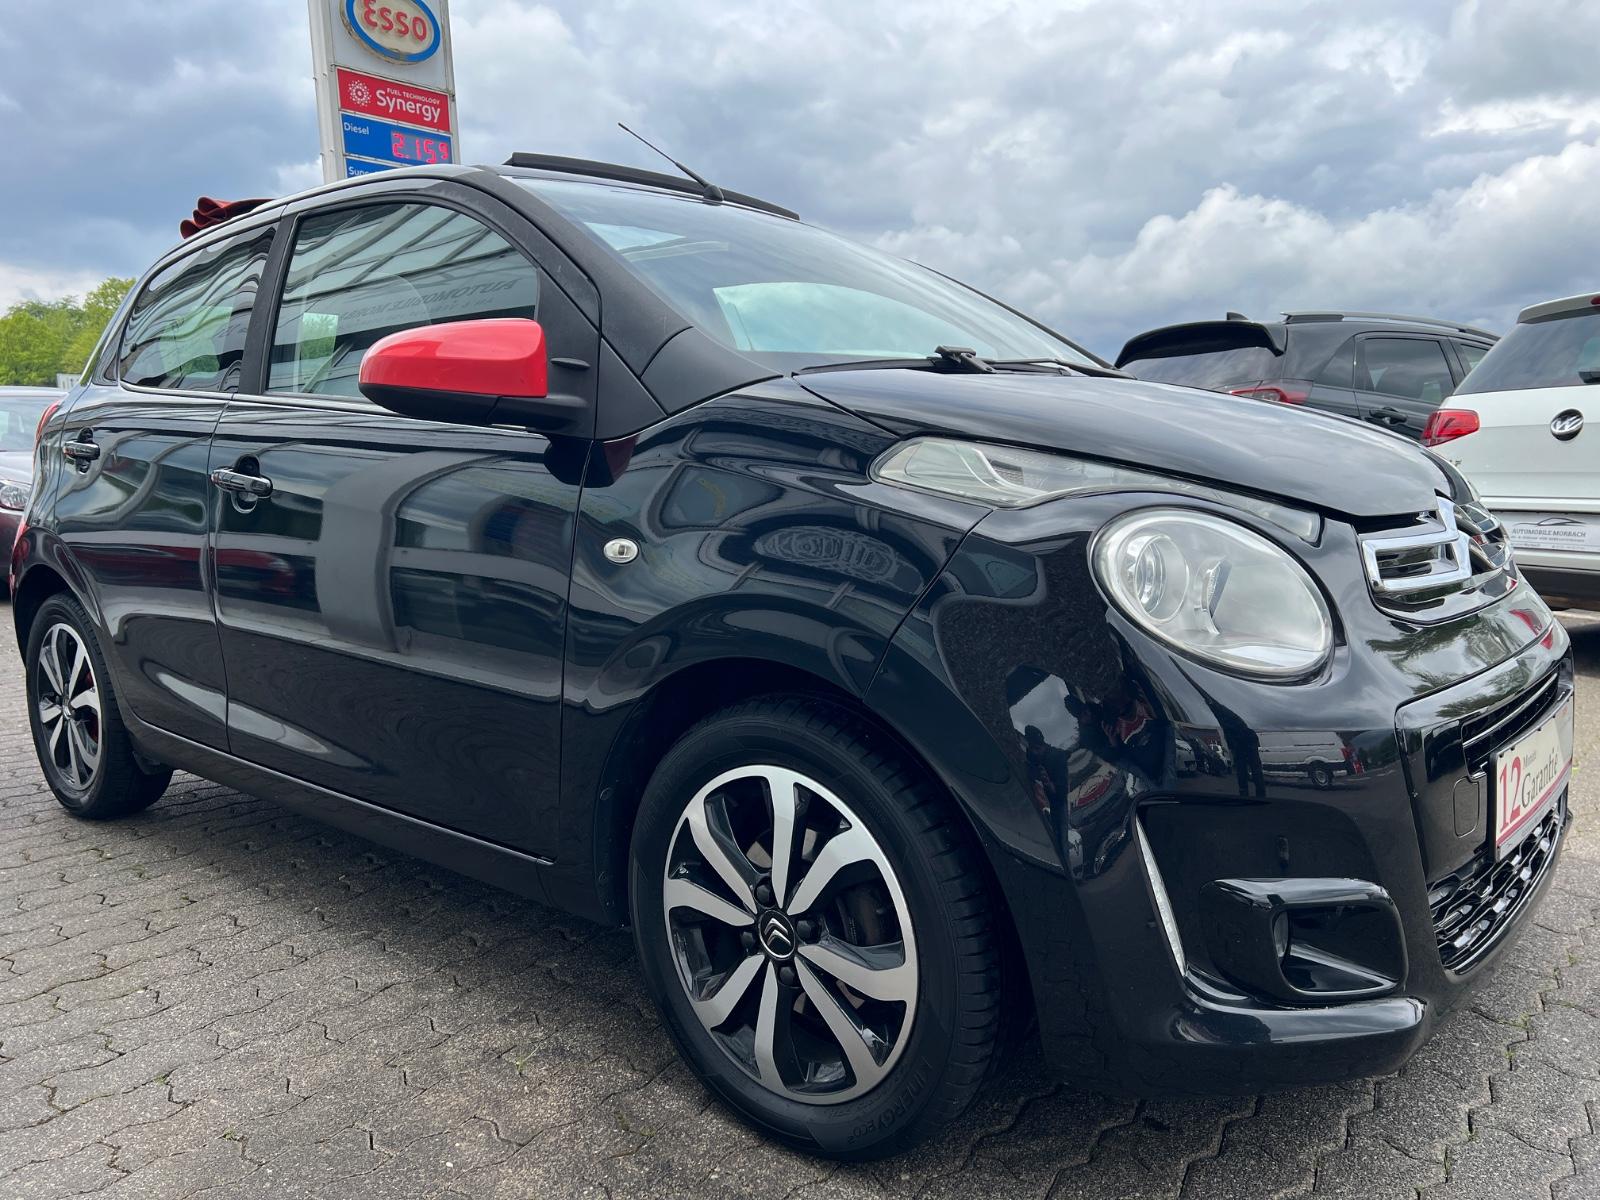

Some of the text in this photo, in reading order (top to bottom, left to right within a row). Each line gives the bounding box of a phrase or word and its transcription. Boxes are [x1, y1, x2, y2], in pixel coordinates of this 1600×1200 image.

[376, 89, 441, 123] Synergy
[387, 88, 440, 105] FUEL TECHNOLOGY
[343, 122, 370, 135] Diesel
[1499, 755, 1521, 834] 12
